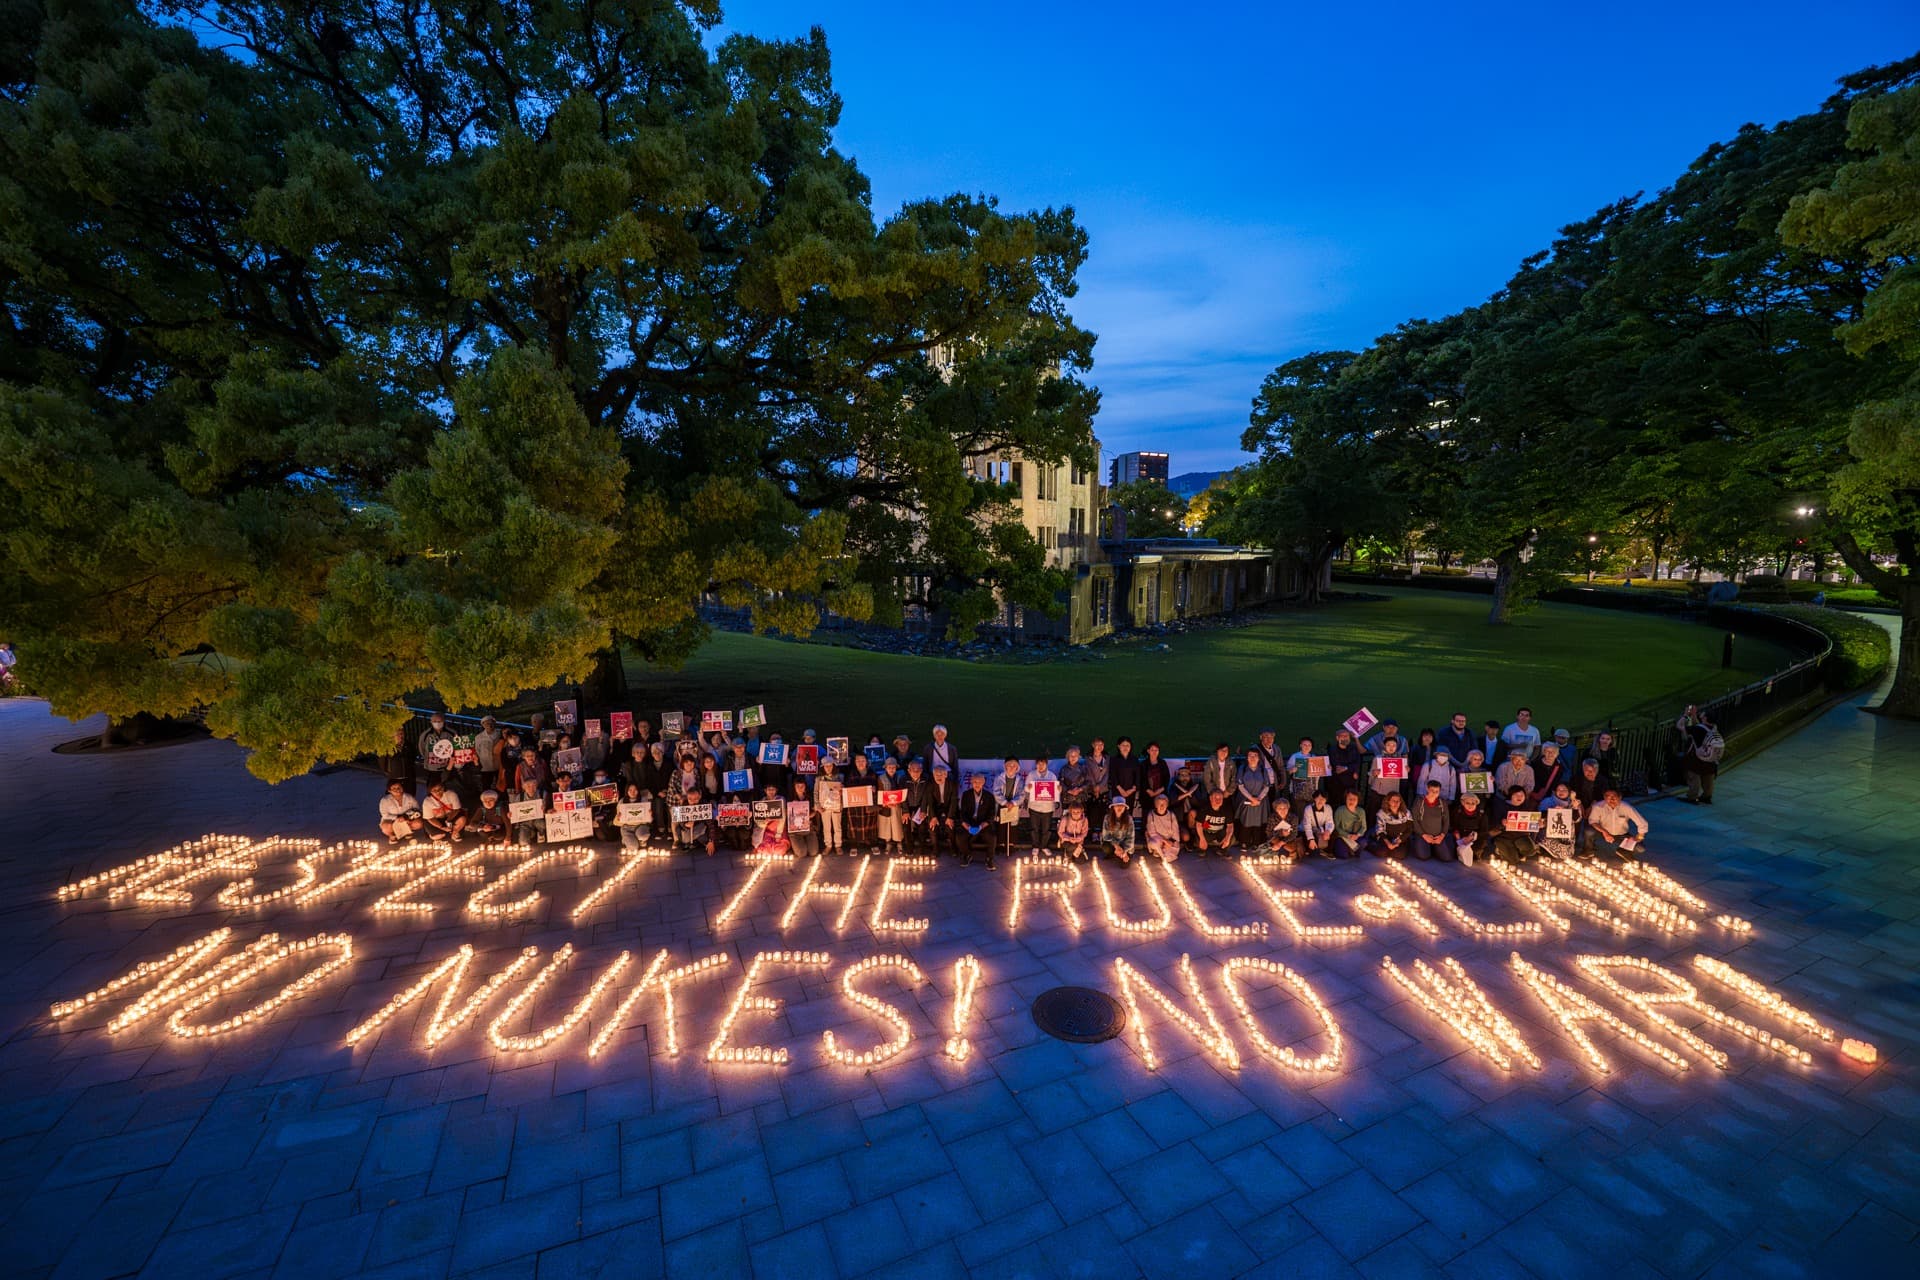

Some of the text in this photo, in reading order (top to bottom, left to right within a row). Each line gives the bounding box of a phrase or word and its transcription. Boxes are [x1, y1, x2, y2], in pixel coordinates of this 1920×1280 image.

[1205, 815, 1226, 824] FREE
[56, 833, 672, 919] RESPECT
[716, 853, 937, 931] THE
[1008, 854, 1365, 937] RULE
[49, 926, 354, 1039] NO
[1114, 952, 1344, 1073] NO
